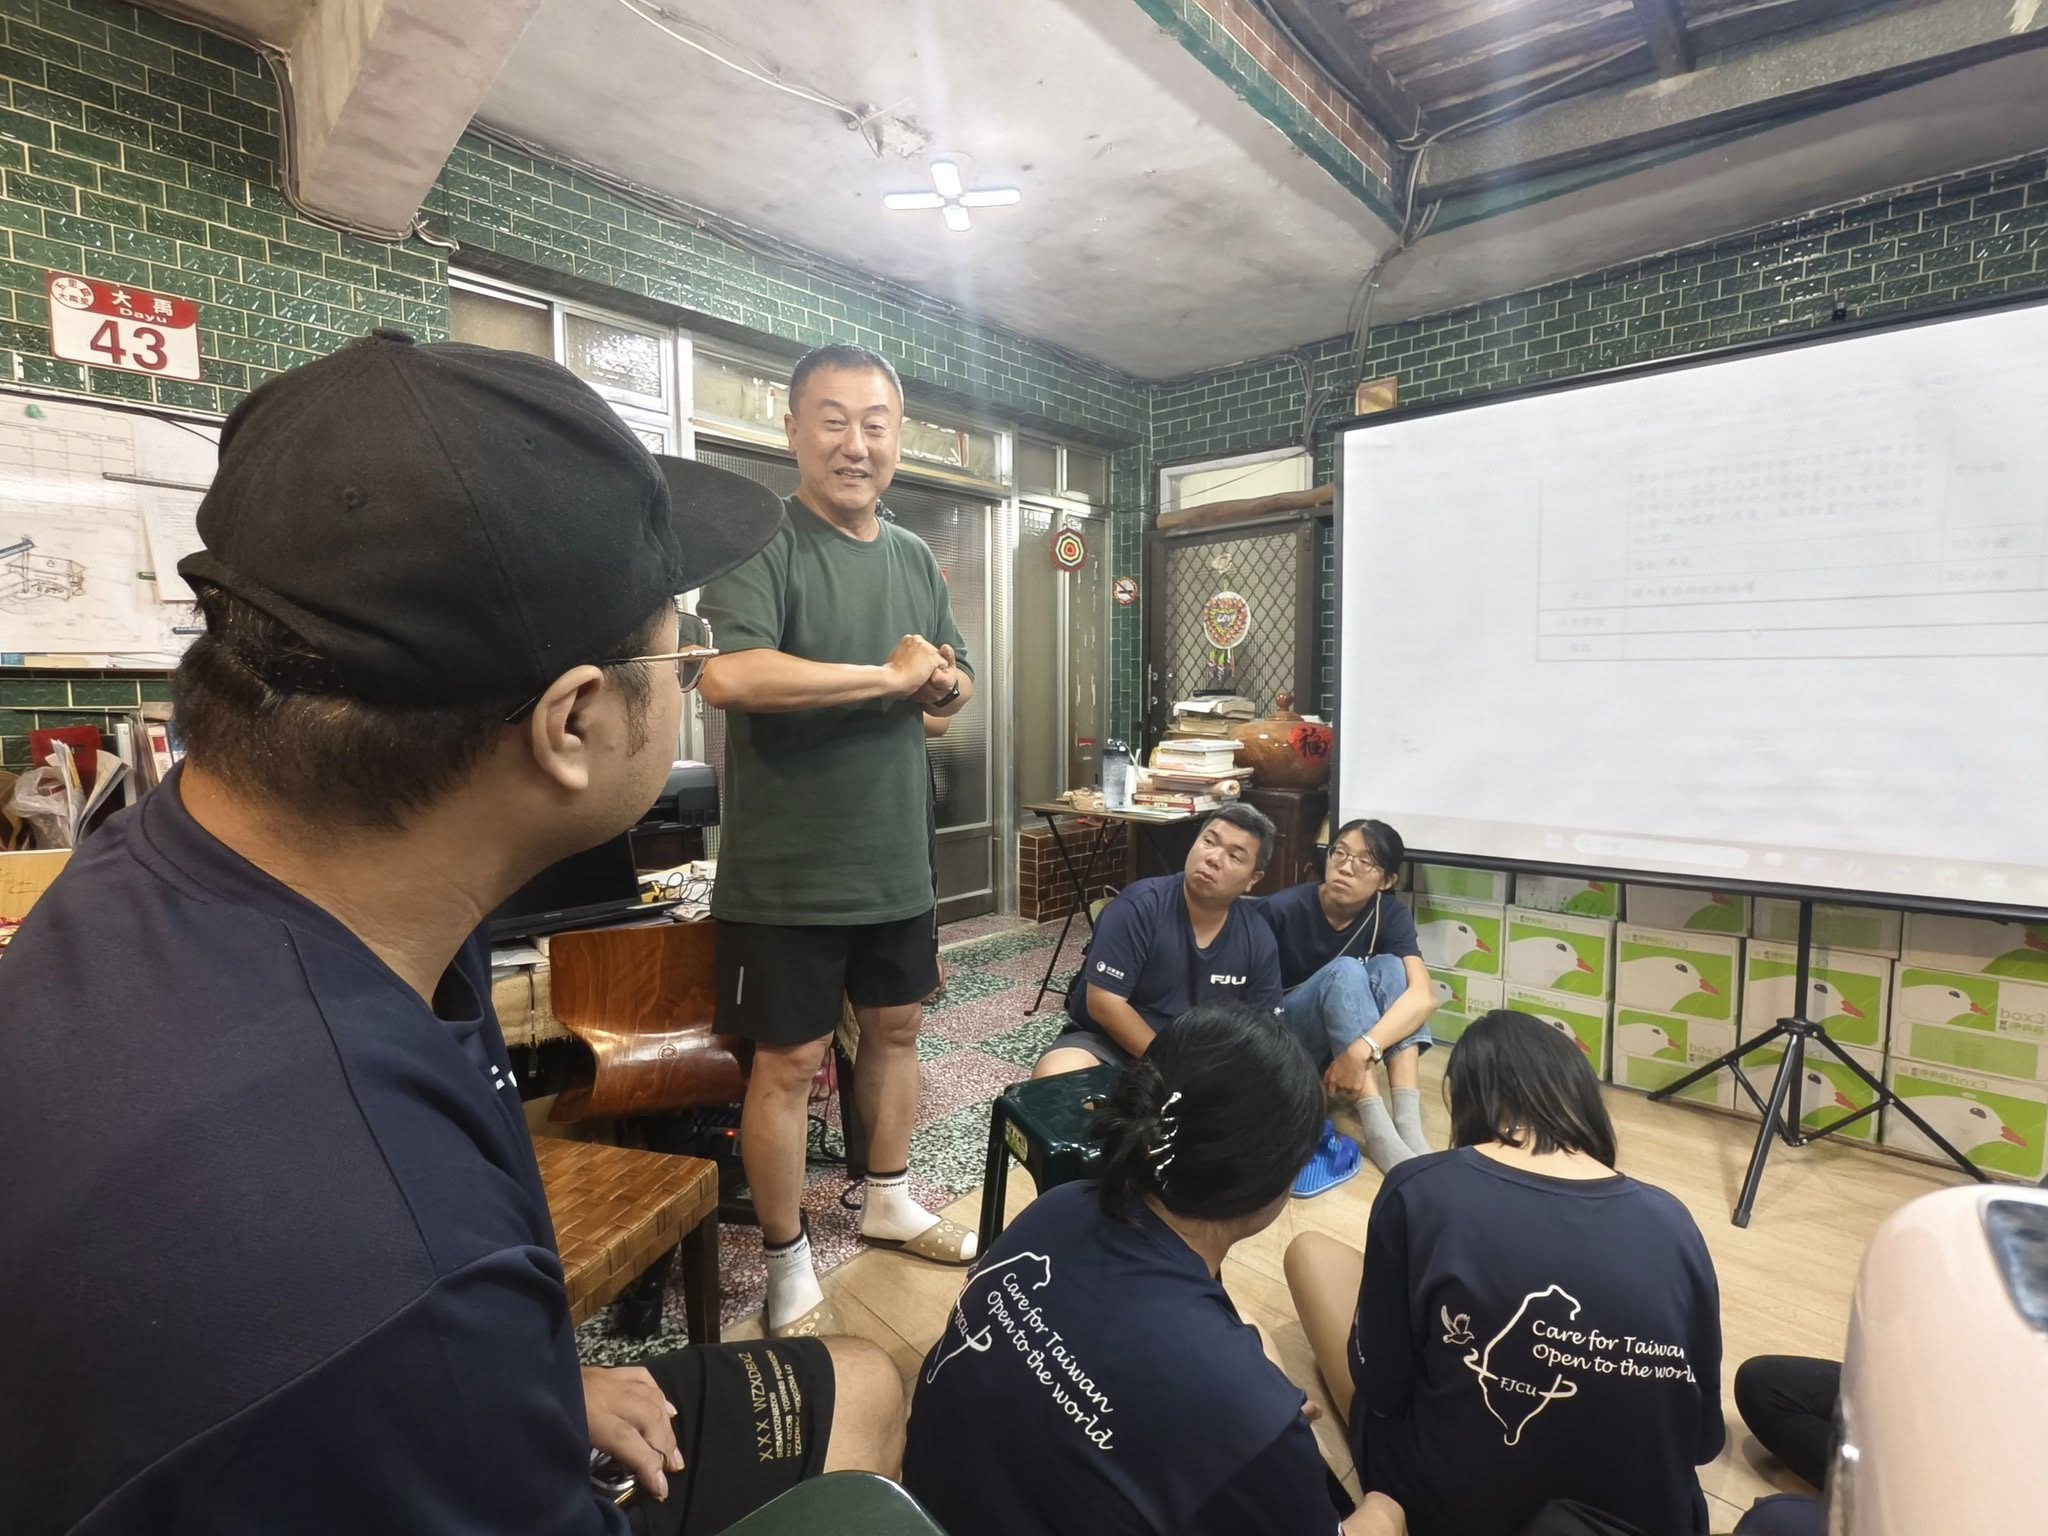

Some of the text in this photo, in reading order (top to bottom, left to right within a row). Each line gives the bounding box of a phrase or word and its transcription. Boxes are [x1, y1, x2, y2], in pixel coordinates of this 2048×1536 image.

[112, 290, 173, 317] 大禹
[119, 307, 167, 324] Dayu
[90, 319, 168, 371] 43
[1299, 727, 1329, 759] 福
[1210, 973, 1247, 985] FJU
[1002, 1272, 1114, 1413] Care for Taiwan
[1532, 1319, 1586, 1345] Care
[1588, 1330, 1619, 1352] for
[987, 1291, 1113, 1450] Open to the world
[1532, 1344, 1591, 1370] Open
[1593, 1356, 1617, 1374] to
[1620, 1358, 1653, 1378] the
[1500, 1377, 1538, 1397] FJCU
